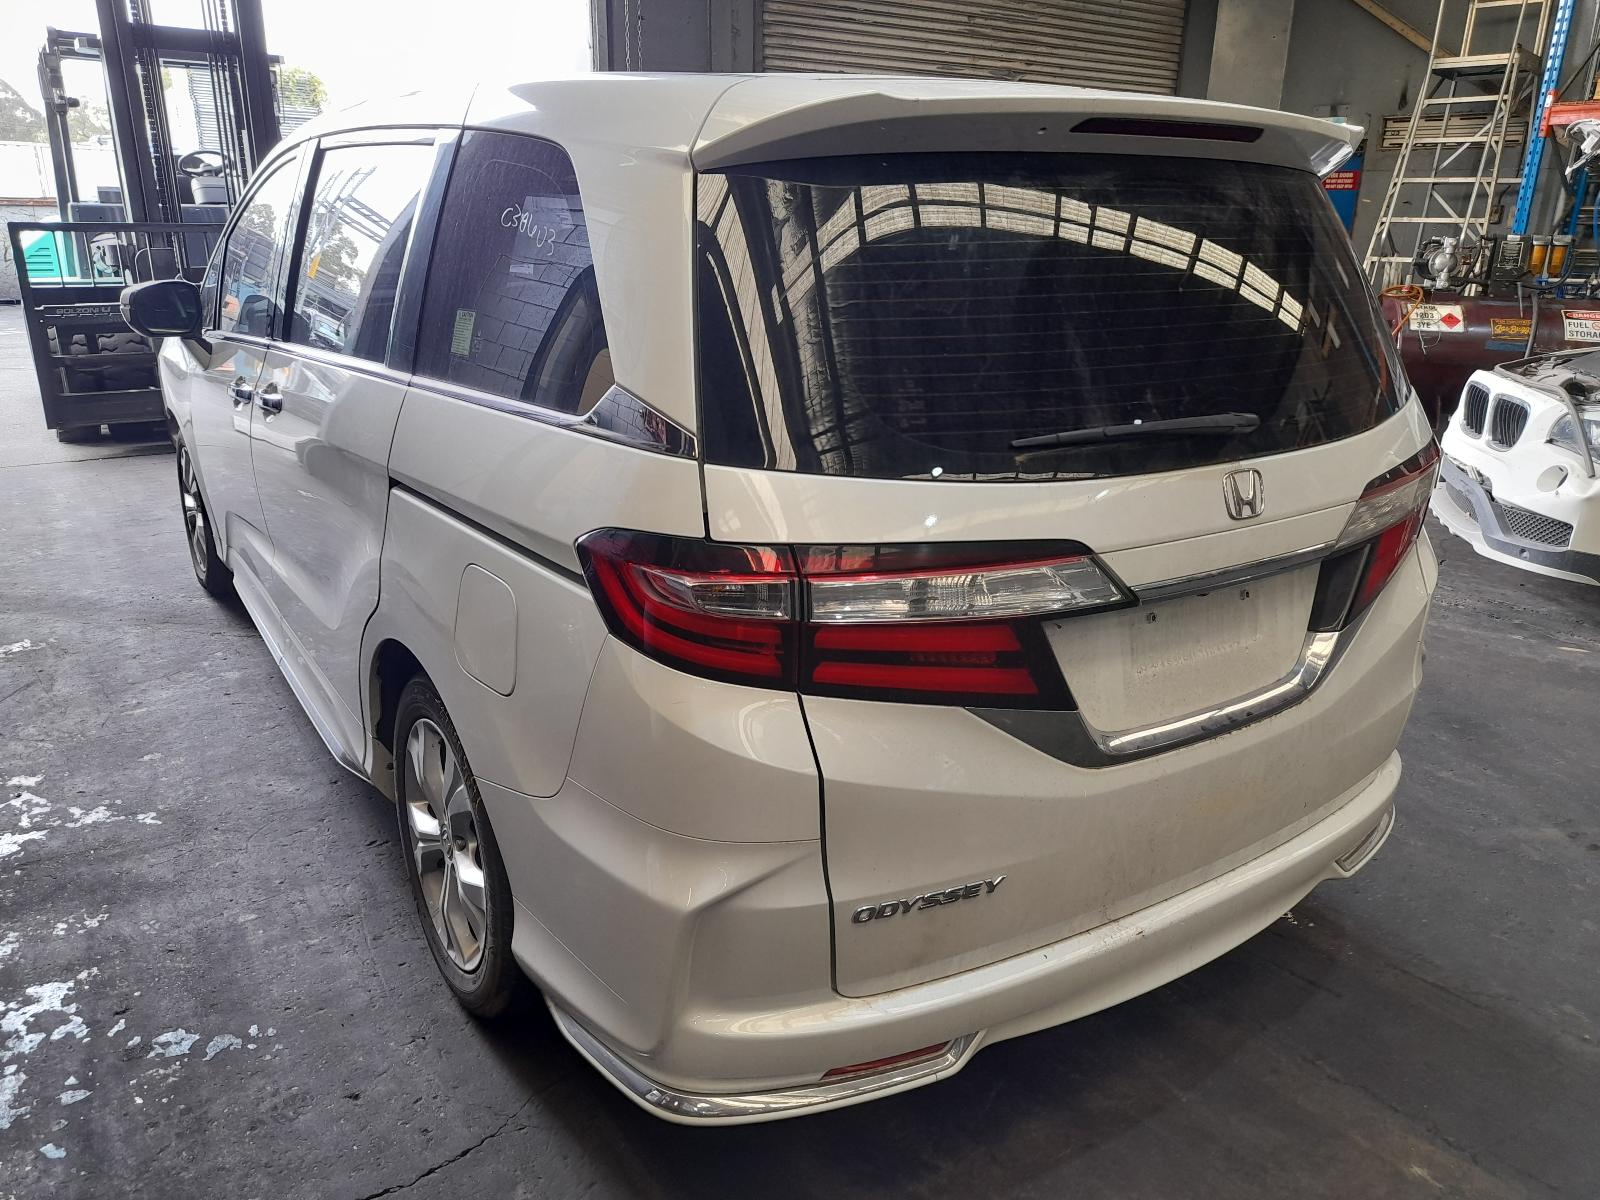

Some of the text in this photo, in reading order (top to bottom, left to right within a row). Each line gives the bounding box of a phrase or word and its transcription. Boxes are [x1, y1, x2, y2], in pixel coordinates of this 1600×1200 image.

[1568, 321, 1590, 329] FUEL
[1568, 330, 1600, 339] STORA
[851, 874, 1008, 924] ODYSSEY
